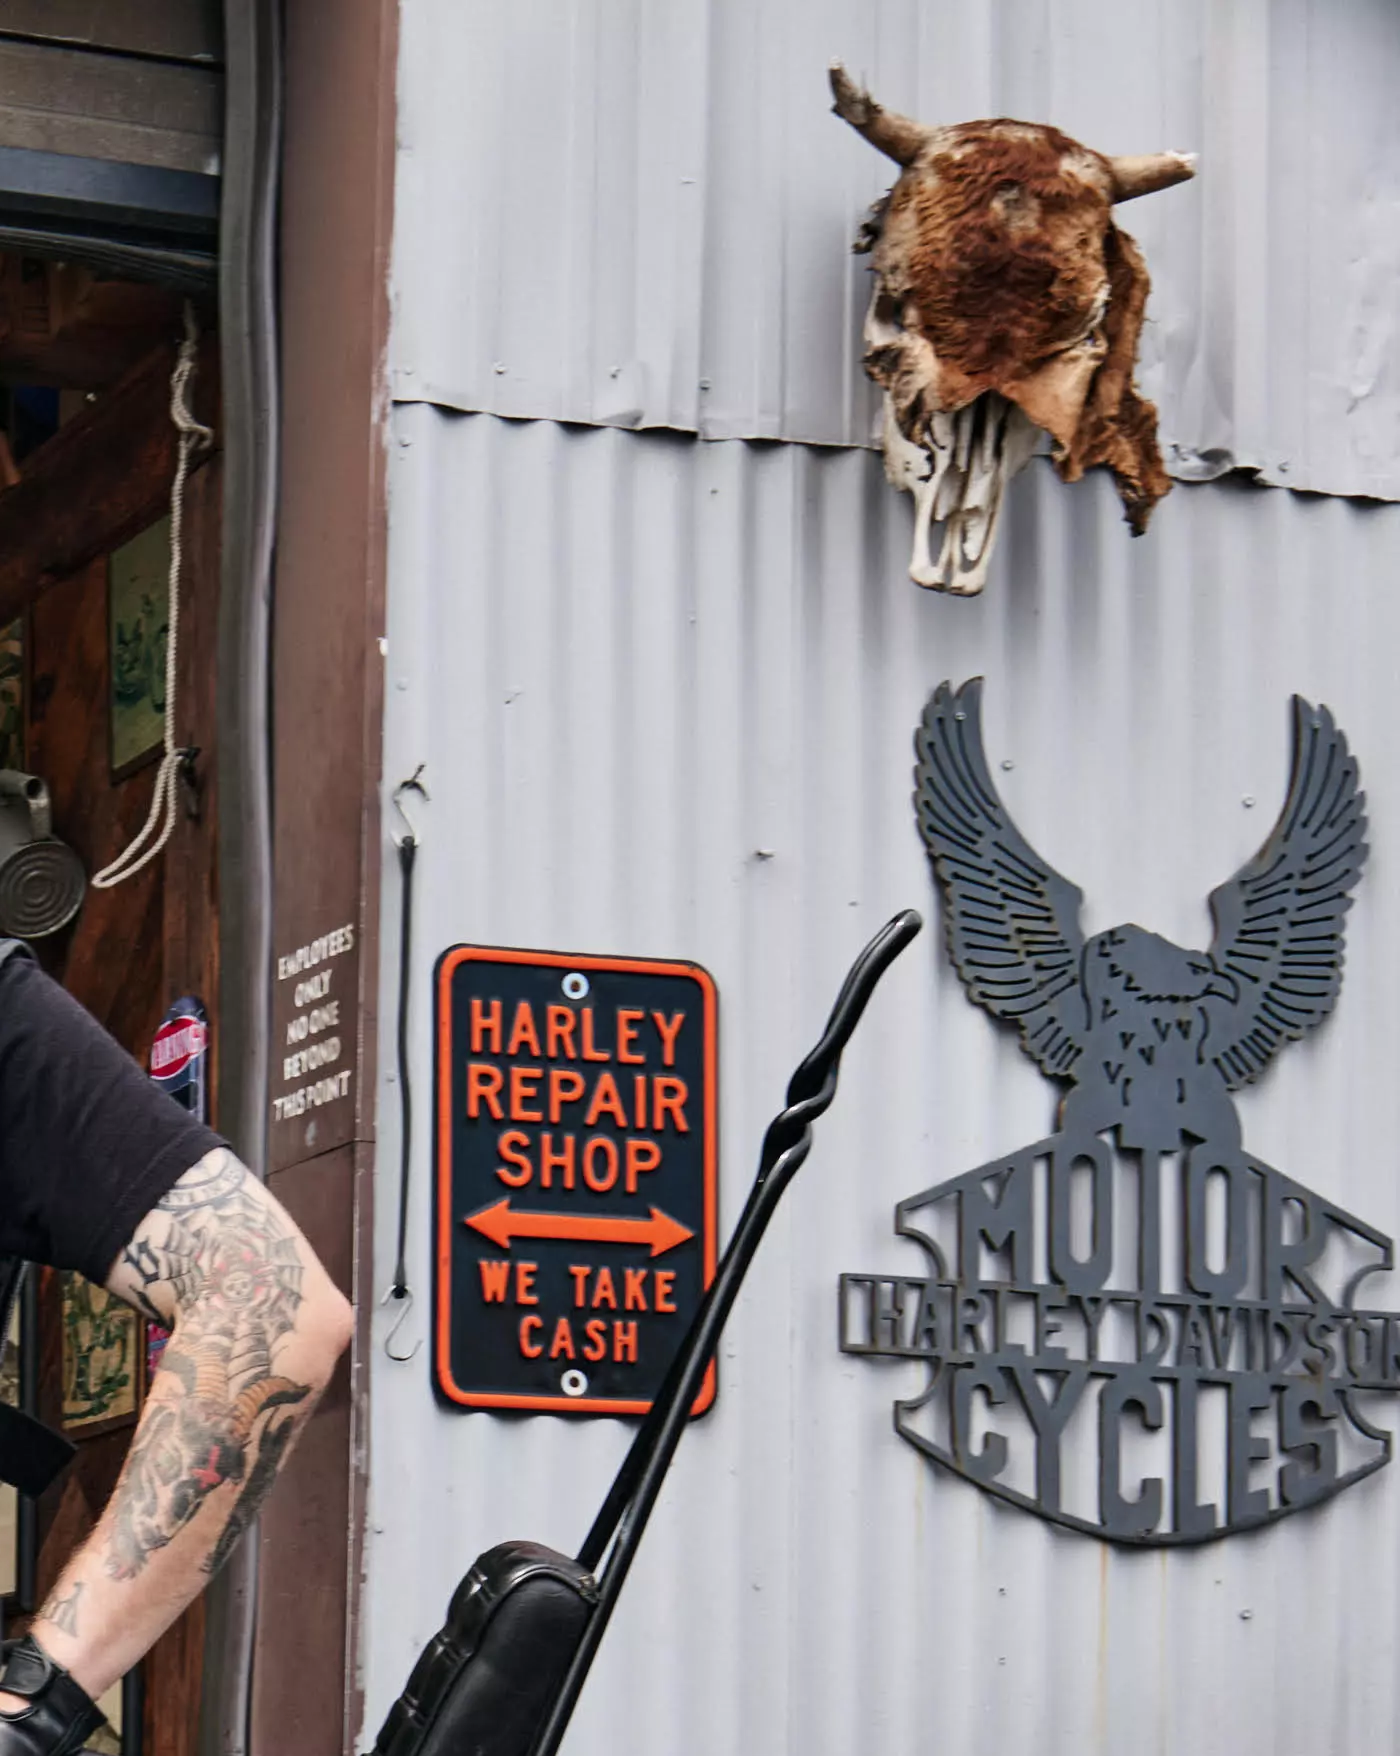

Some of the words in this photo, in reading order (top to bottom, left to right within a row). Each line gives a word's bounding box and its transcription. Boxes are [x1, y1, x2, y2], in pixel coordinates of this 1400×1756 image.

[277, 923, 354, 980] EMPLOYEES
[294, 968, 332, 1007] ONLY
[286, 1015, 308, 1045] NO
[309, 1000, 339, 1034] ONE
[470, 999, 685, 1067] HARLEY
[284, 1036, 341, 1080] BEYOND
[272, 1087, 306, 1121] THIS
[306, 1070, 351, 1109] POINT
[467, 1063, 689, 1133] REPAIR
[495, 1130, 661, 1193] SHOP
[956, 1135, 1336, 1306] MOTOR
[479, 1260, 539, 1305] WE
[568, 1265, 677, 1313] TAKE
[519, 1315, 638, 1363] CASH
[870, 1278, 1106, 1364] HARLEY
[951, 1363, 1338, 1538] CYCLES
